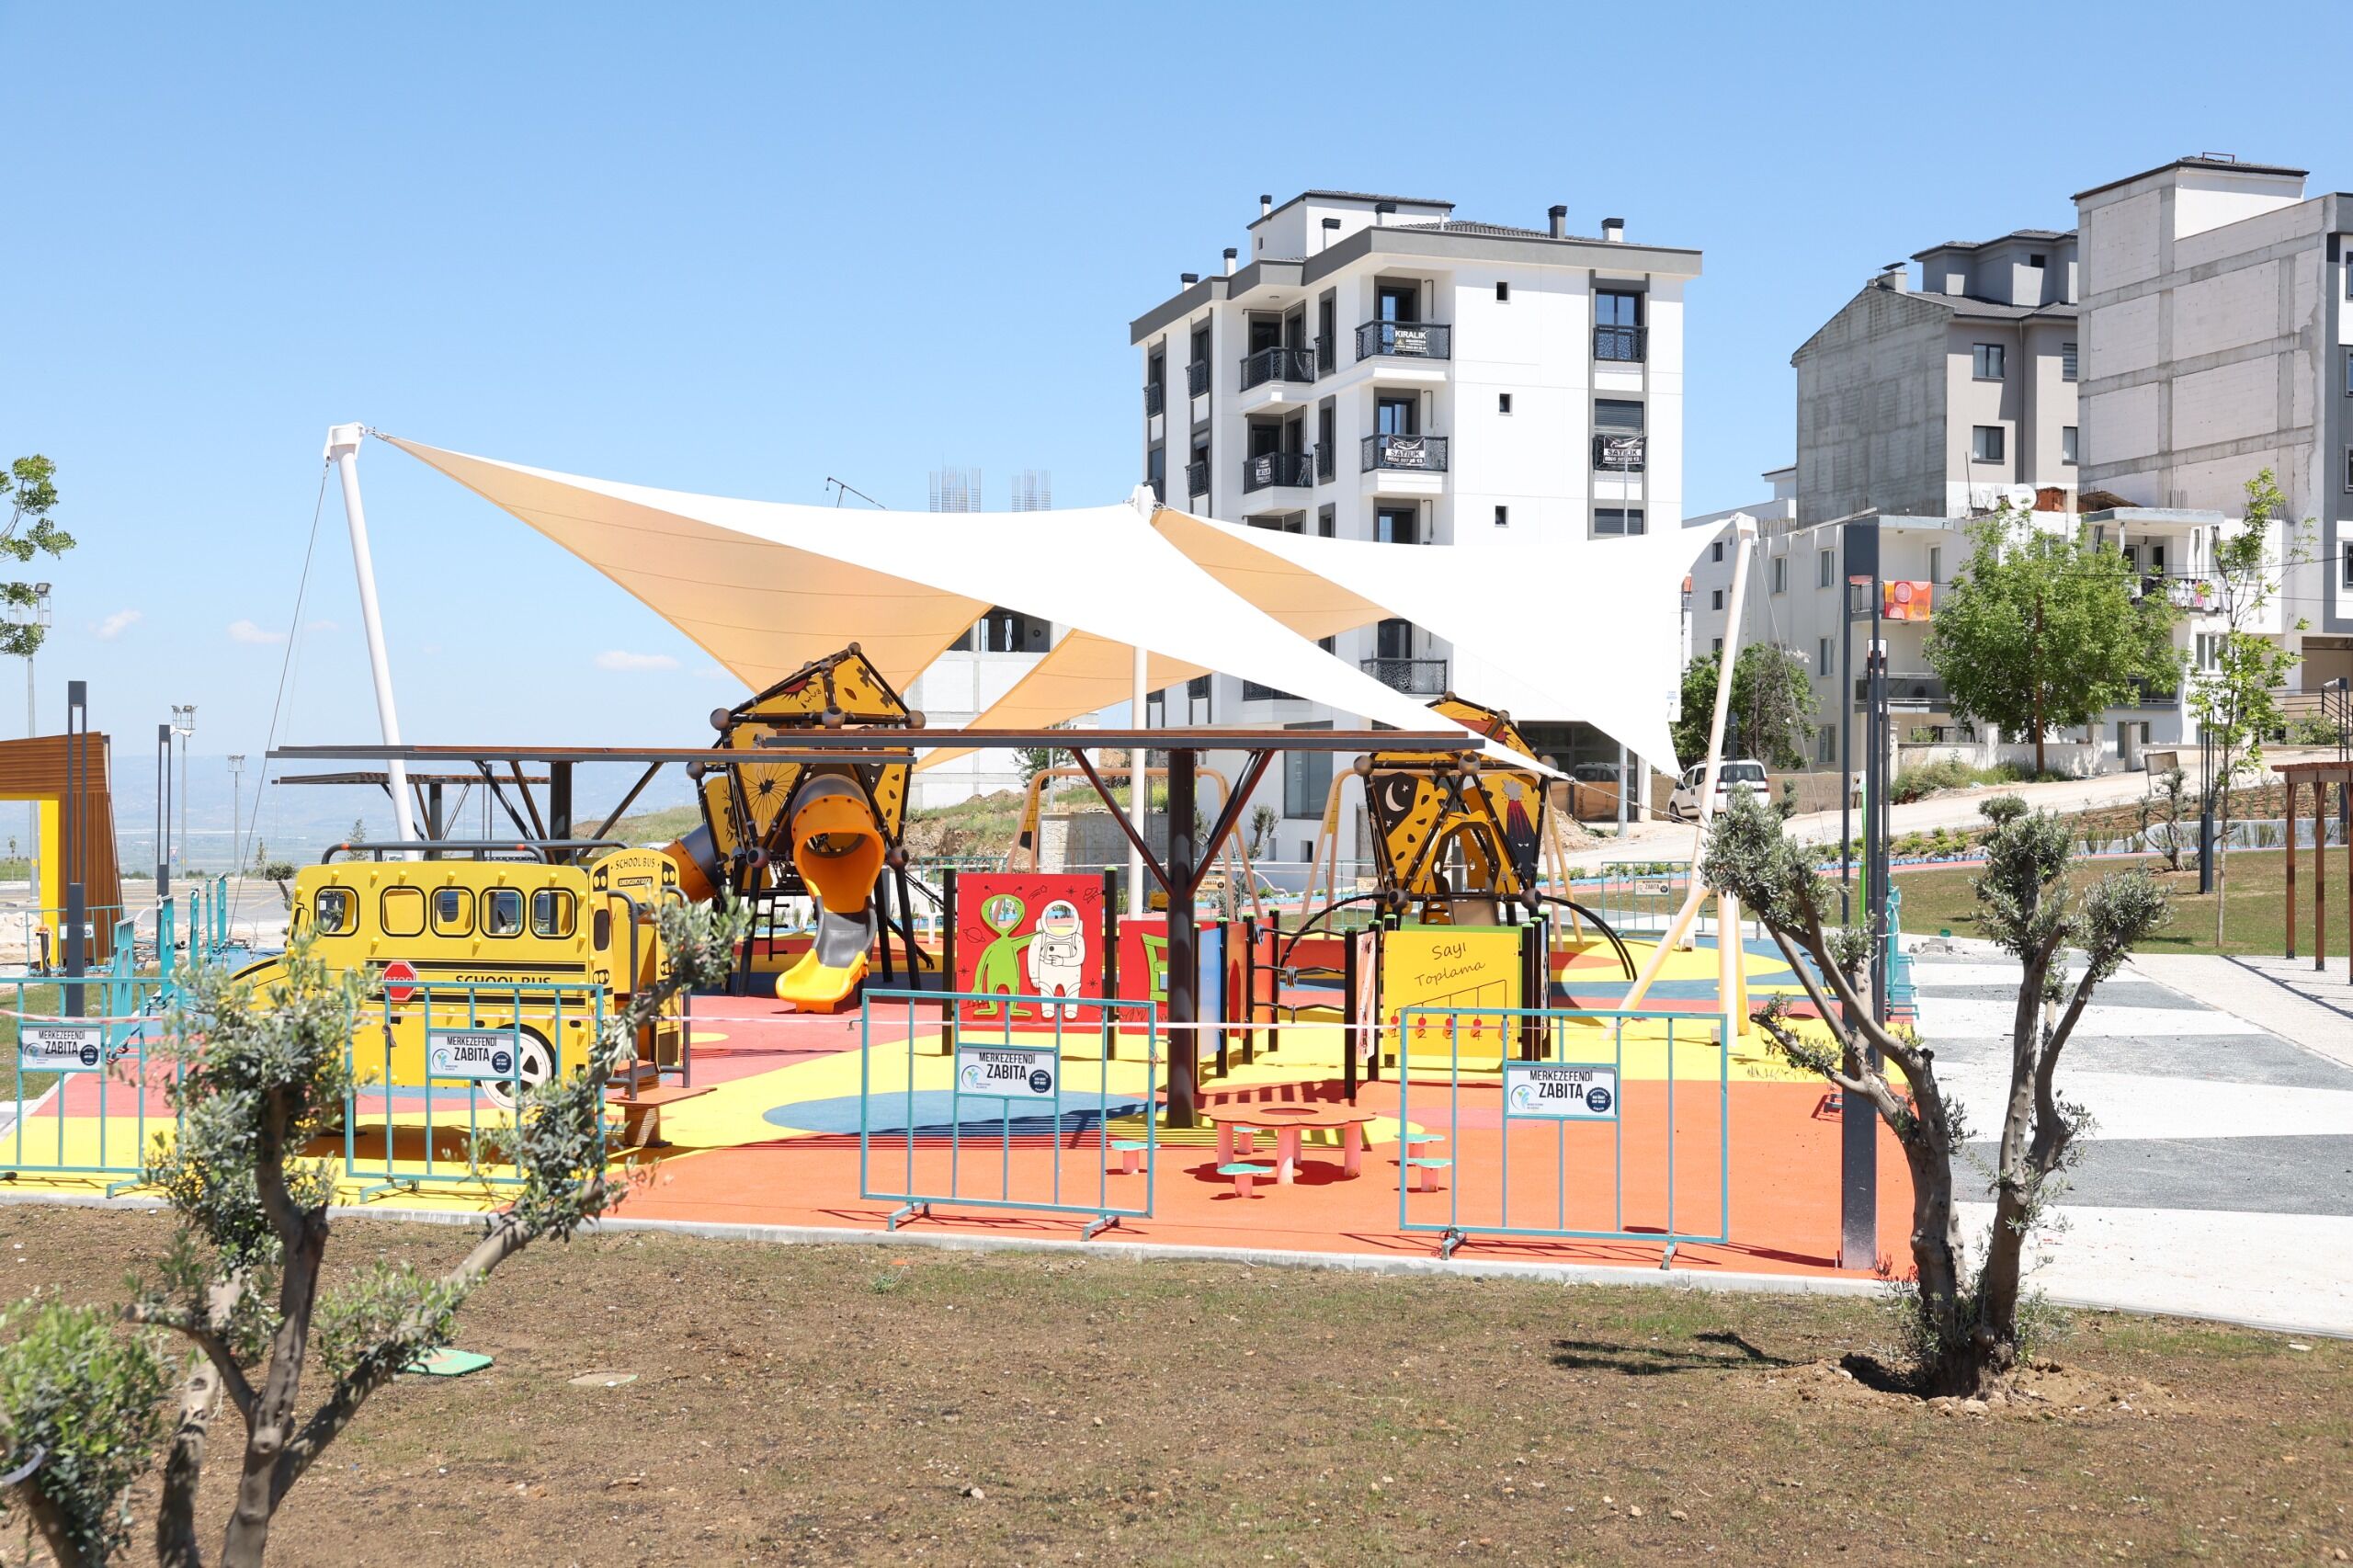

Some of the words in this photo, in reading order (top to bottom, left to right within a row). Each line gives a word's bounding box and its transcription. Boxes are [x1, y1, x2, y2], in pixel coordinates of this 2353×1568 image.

[1394, 330, 1427, 339] KIRALIK
[616, 858, 641, 869] SCHOOL
[643, 858, 655, 869] BUS
[1432, 942, 1466, 960] Sayı
[1415, 961, 1486, 986] Toplama
[38, 1029, 85, 1040] MERKEZEFENDİ
[1417, 1028, 1427, 1039] 2
[1472, 1029, 1483, 1040] 4
[447, 1036, 497, 1046] MERKEZEFENDİ
[45, 1041, 78, 1054] ZABITA
[454, 1047, 490, 1062] ZABITA
[979, 1052, 1036, 1064] MERKEZEFENDİ
[987, 1064, 1027, 1080] ZABITA
[1529, 1070, 1593, 1082] MERKEZEFENDİ
[1539, 1083, 1584, 1098] ZABITA
